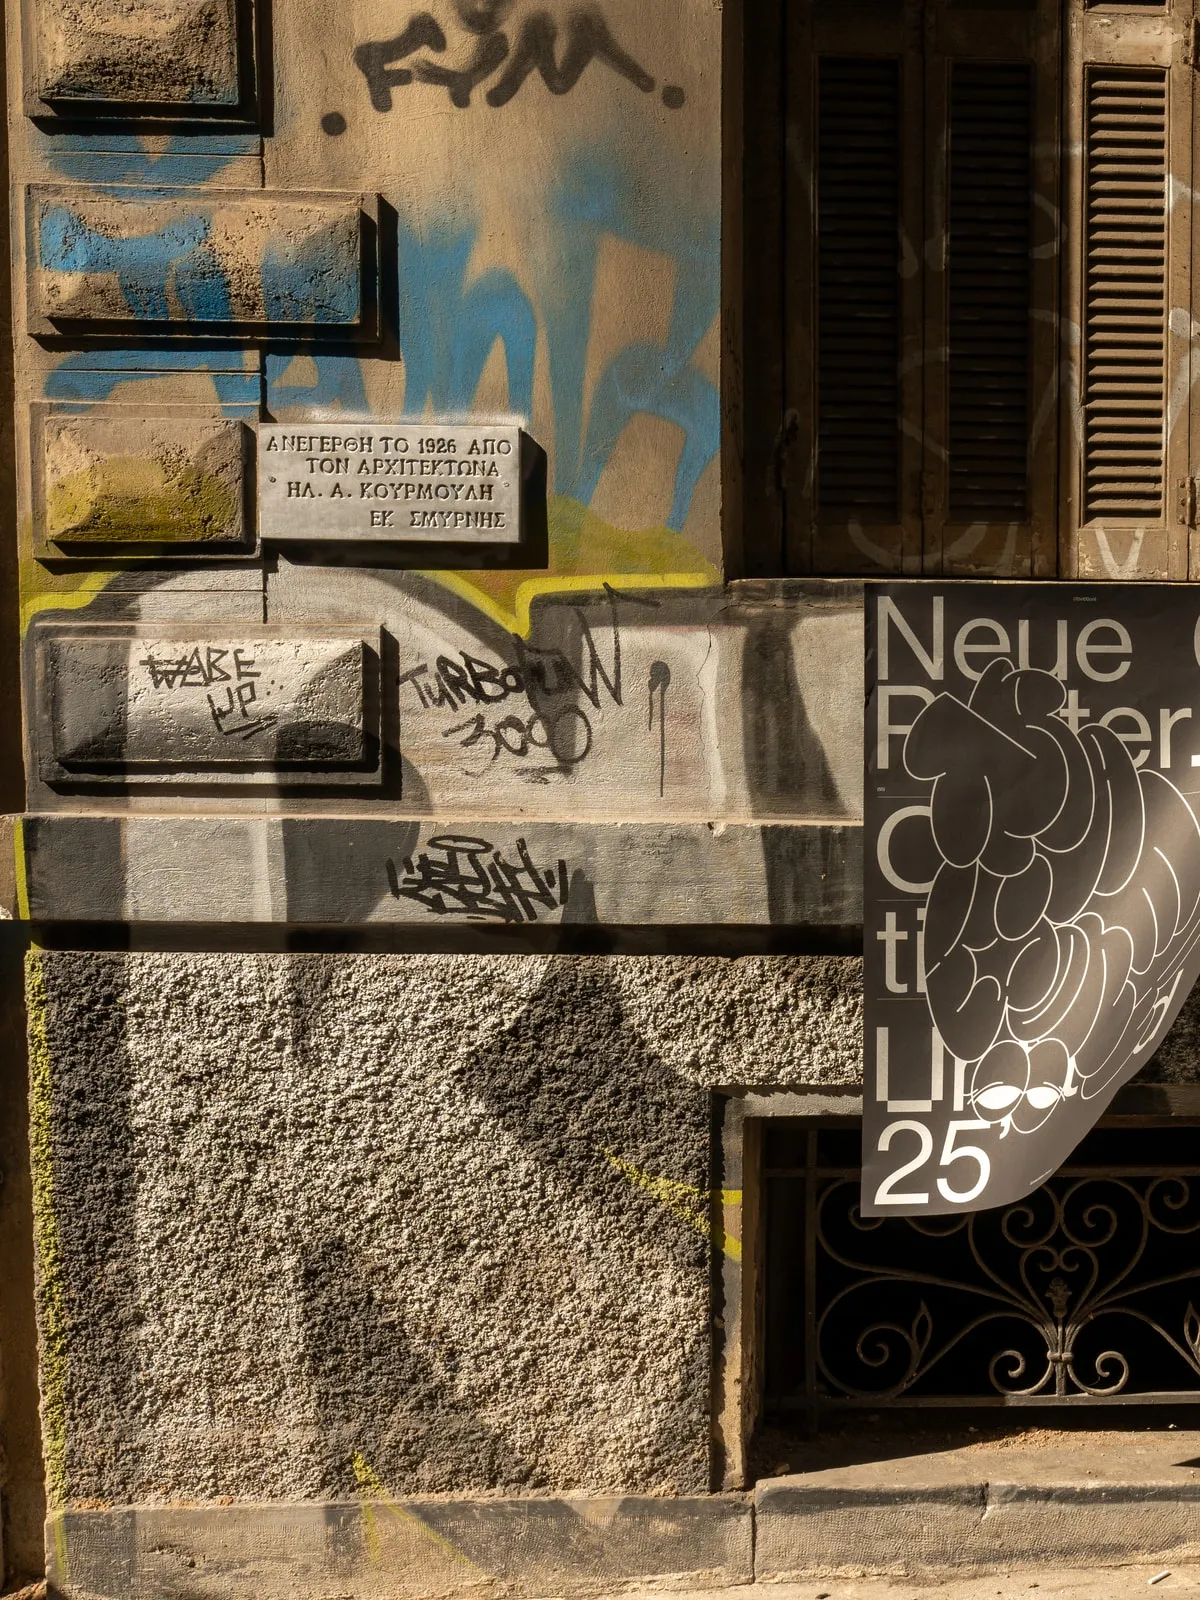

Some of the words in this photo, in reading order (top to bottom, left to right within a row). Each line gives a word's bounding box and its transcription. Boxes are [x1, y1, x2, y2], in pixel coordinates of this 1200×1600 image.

[266, 435, 373, 454] ΑΝΕΓΕΡΘΗ
[380, 437, 409, 455] ΤΟ
[418, 438, 457, 455] 1926
[468, 439, 512, 456] ΑΠΟ
[306, 457, 350, 475] ΤΟΝ
[358, 458, 500, 477] ΑΡΧΙΤΕΚΤΩΝΑ
[287, 481, 323, 499] ΗΛ.
[331, 482, 352, 500] Α.
[360, 482, 494, 501] ΚΟΥΡΜΟΥΛΗ
[370, 510, 395, 528] ΕΚ
[410, 511, 506, 529] ΣΜΥΡΝΗΣ
[876, 596, 1132, 683] Neue
